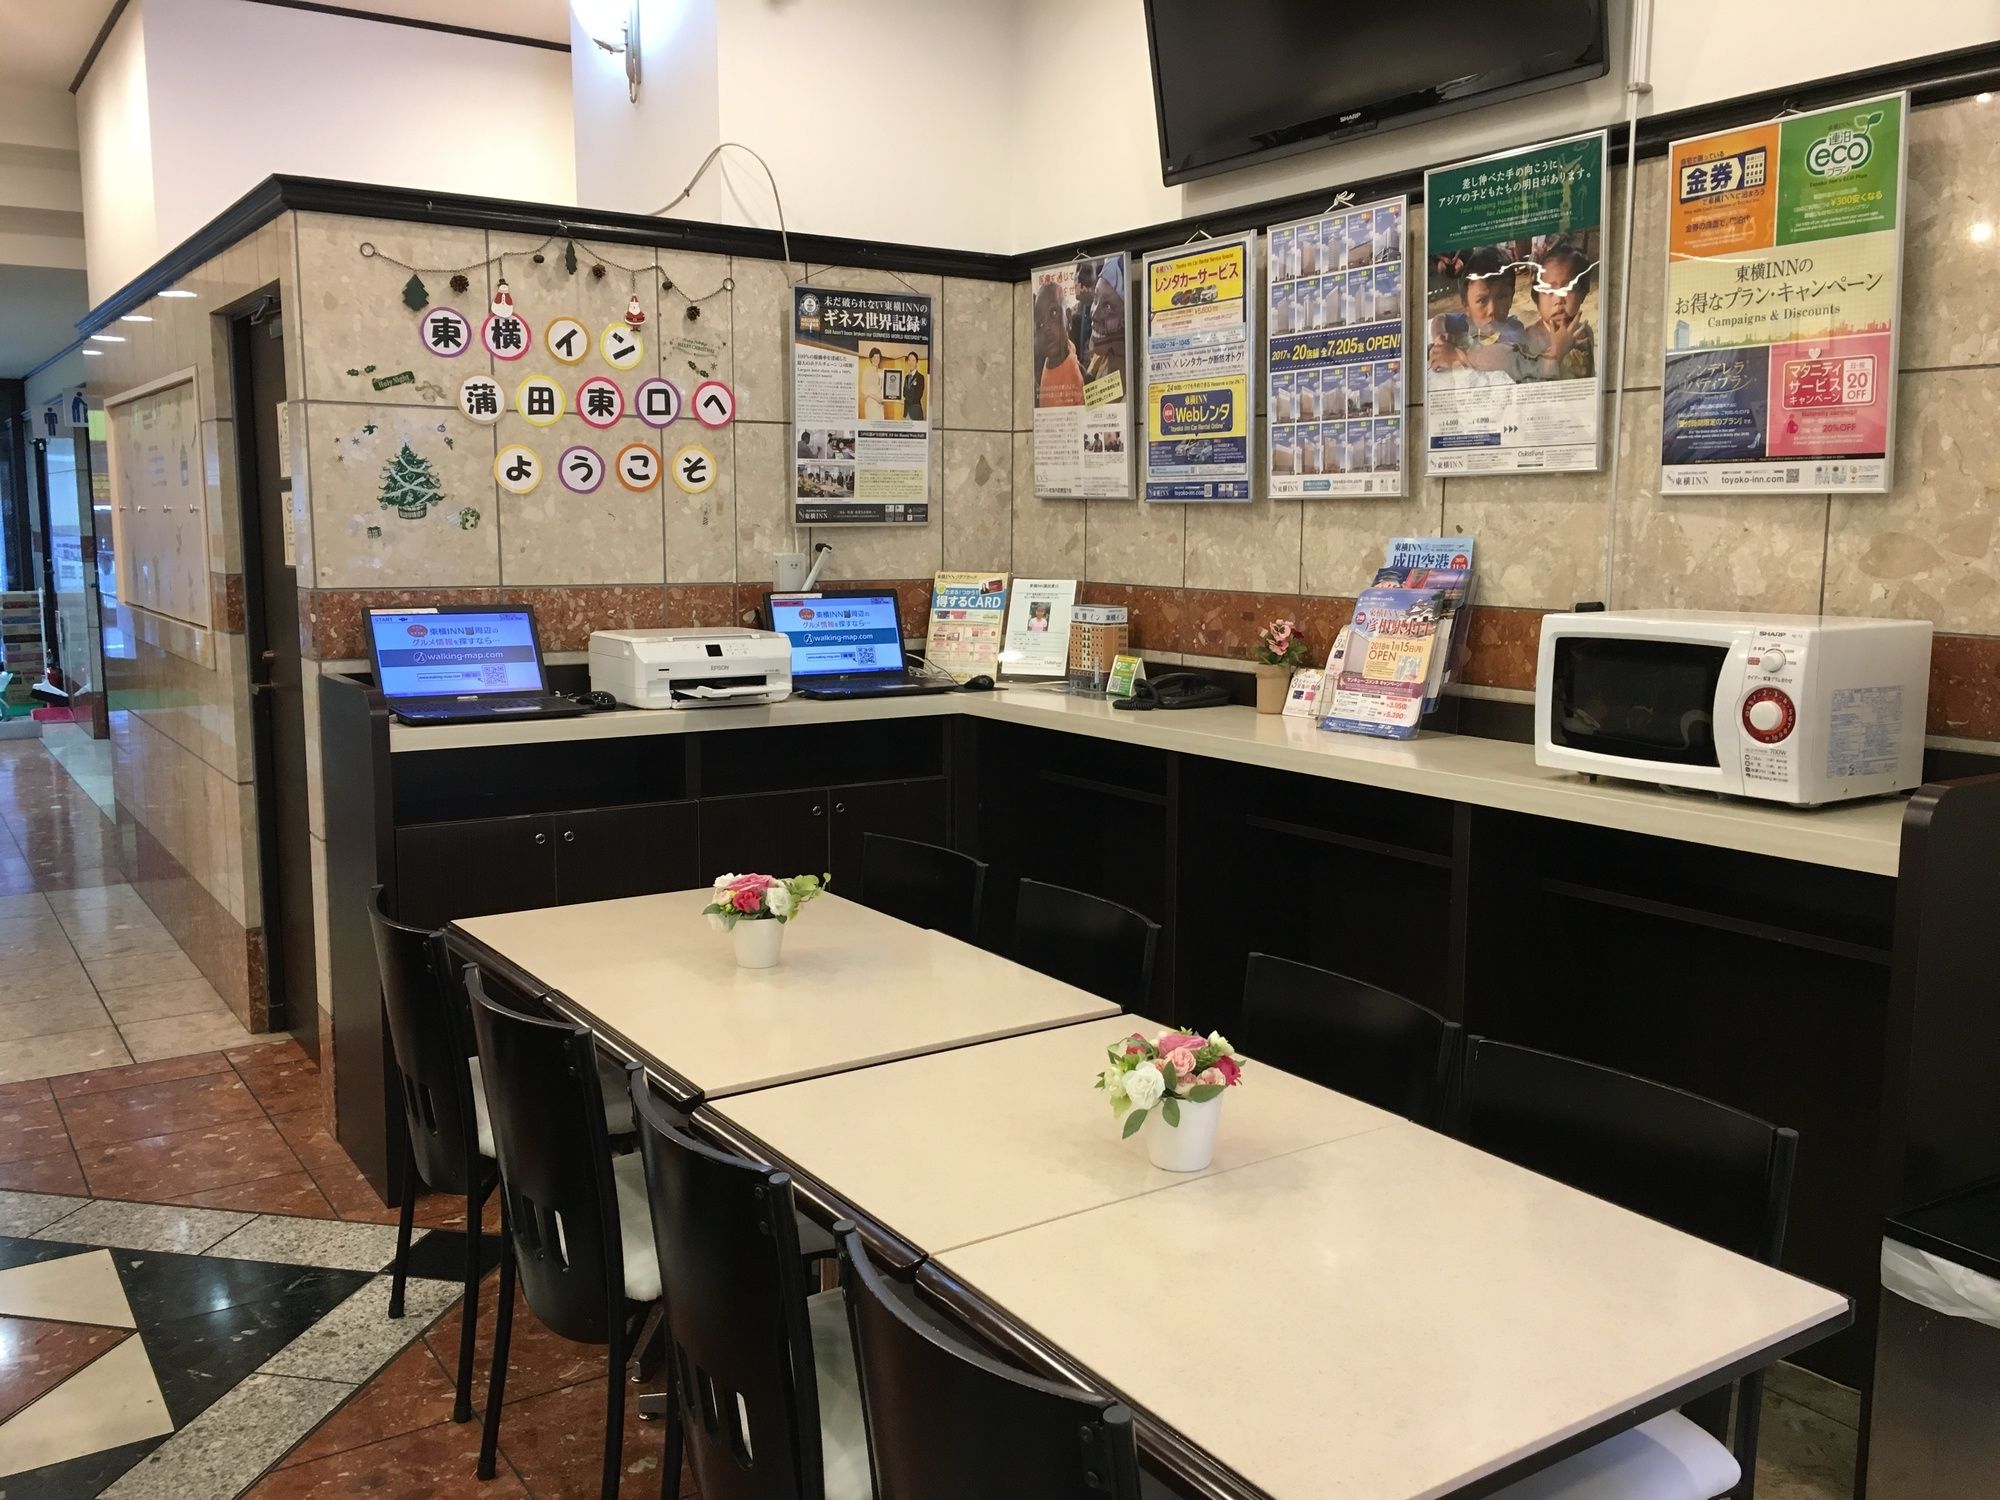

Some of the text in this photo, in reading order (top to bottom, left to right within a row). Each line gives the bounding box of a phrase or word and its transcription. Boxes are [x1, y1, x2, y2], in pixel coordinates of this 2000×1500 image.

[1340, 112, 1361, 123] SHARP
[1829, 130, 1852, 146] 連泊
[1814, 141, 1864, 168] eco
[1686, 161, 1733, 195] 金券
[1827, 165, 1851, 177] プラン
[1438, 167, 1591, 209] アジアの子どもたちの明日があります。
[1155, 262, 1239, 293] レンタカーサービス
[1735, 257, 1814, 284] 東横INNの
[1674, 271, 1884, 316] お得なプラン・キャンペーン
[824, 295, 928, 313] 未だ破られない東横INNの
[1707, 303, 1841, 329] Campaigns & Discounts
[1366, 333, 1401, 352] OPEN!
[393, 374, 410, 384] Night
[1789, 361, 1842, 379] マタニティ
[1788, 377, 1842, 395] サービス
[1847, 389, 1866, 400] OFF
[1789, 393, 1841, 406] キャンペーン
[1175, 403, 1230, 423] Webレンタ
[506, 454, 707, 484] ようこそ
[1721, 475, 1784, 485] toyoko-inn.com
[936, 595, 1002, 608] 得するCARD
[814, 633, 874, 643] walking-map.com
[427, 651, 504, 662] walking-map.com
[1368, 649, 1398, 662] OPEN
